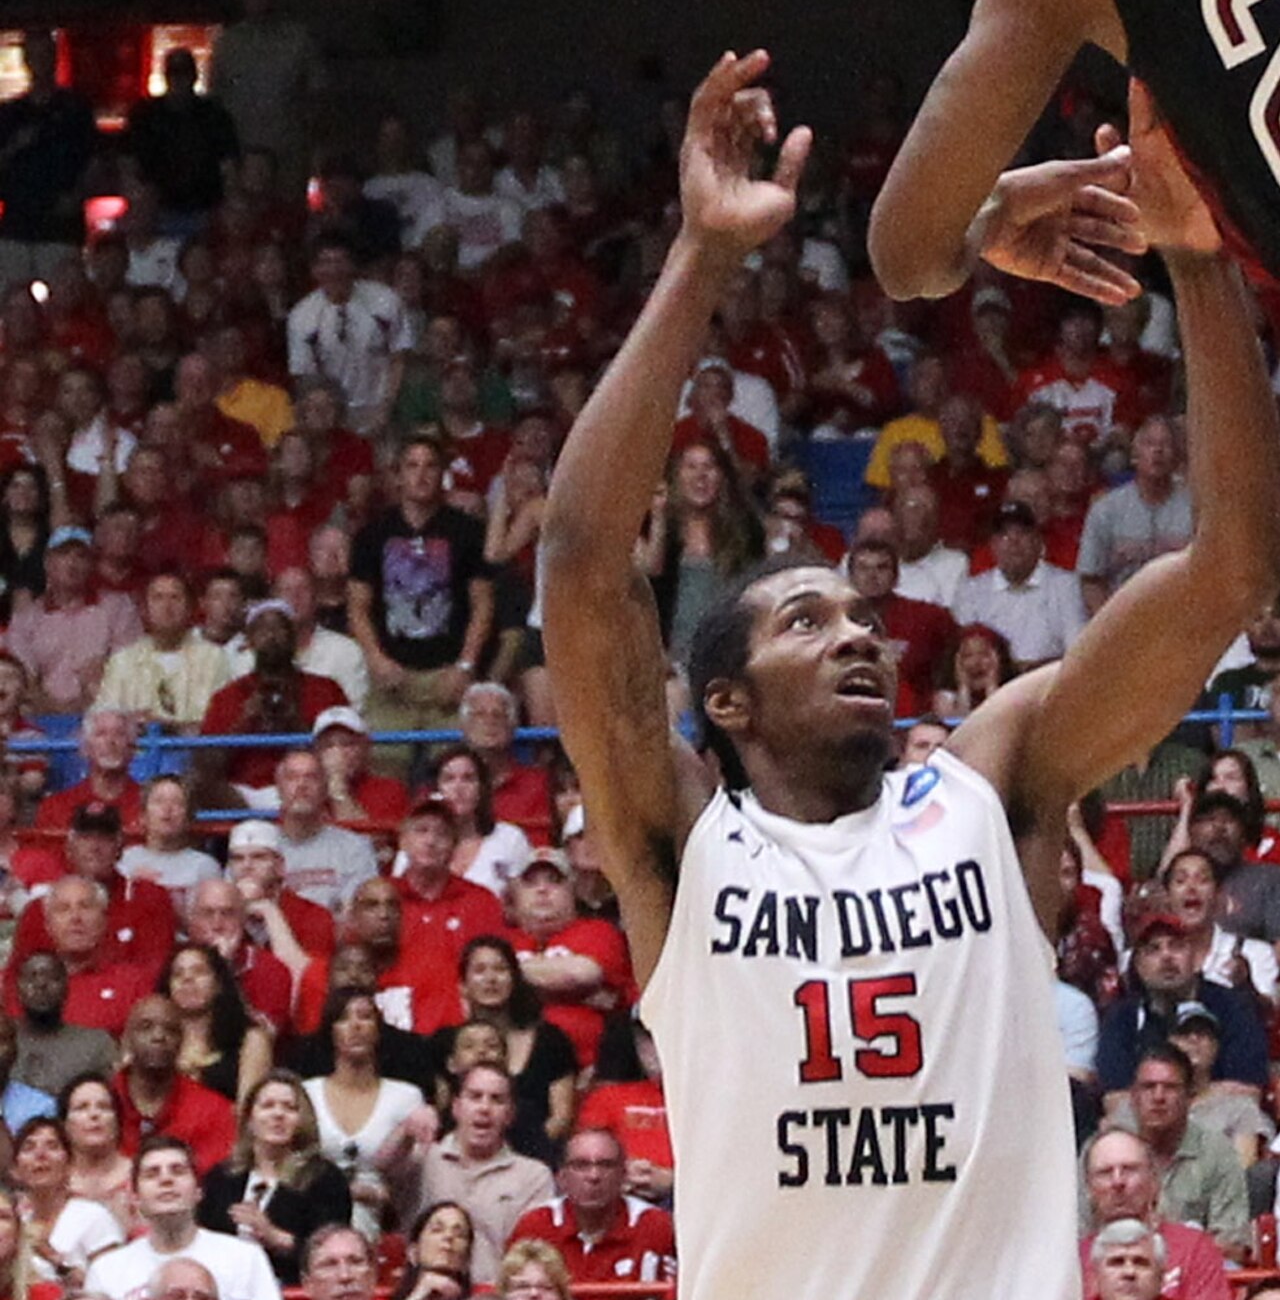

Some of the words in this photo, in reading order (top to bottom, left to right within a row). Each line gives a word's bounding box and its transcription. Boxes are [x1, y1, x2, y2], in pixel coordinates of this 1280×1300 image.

[711, 886, 820, 962] SAN
[835, 859, 993, 958] DIEGO
[794, 972, 924, 1084] 15
[777, 1103, 957, 1188] STATE
